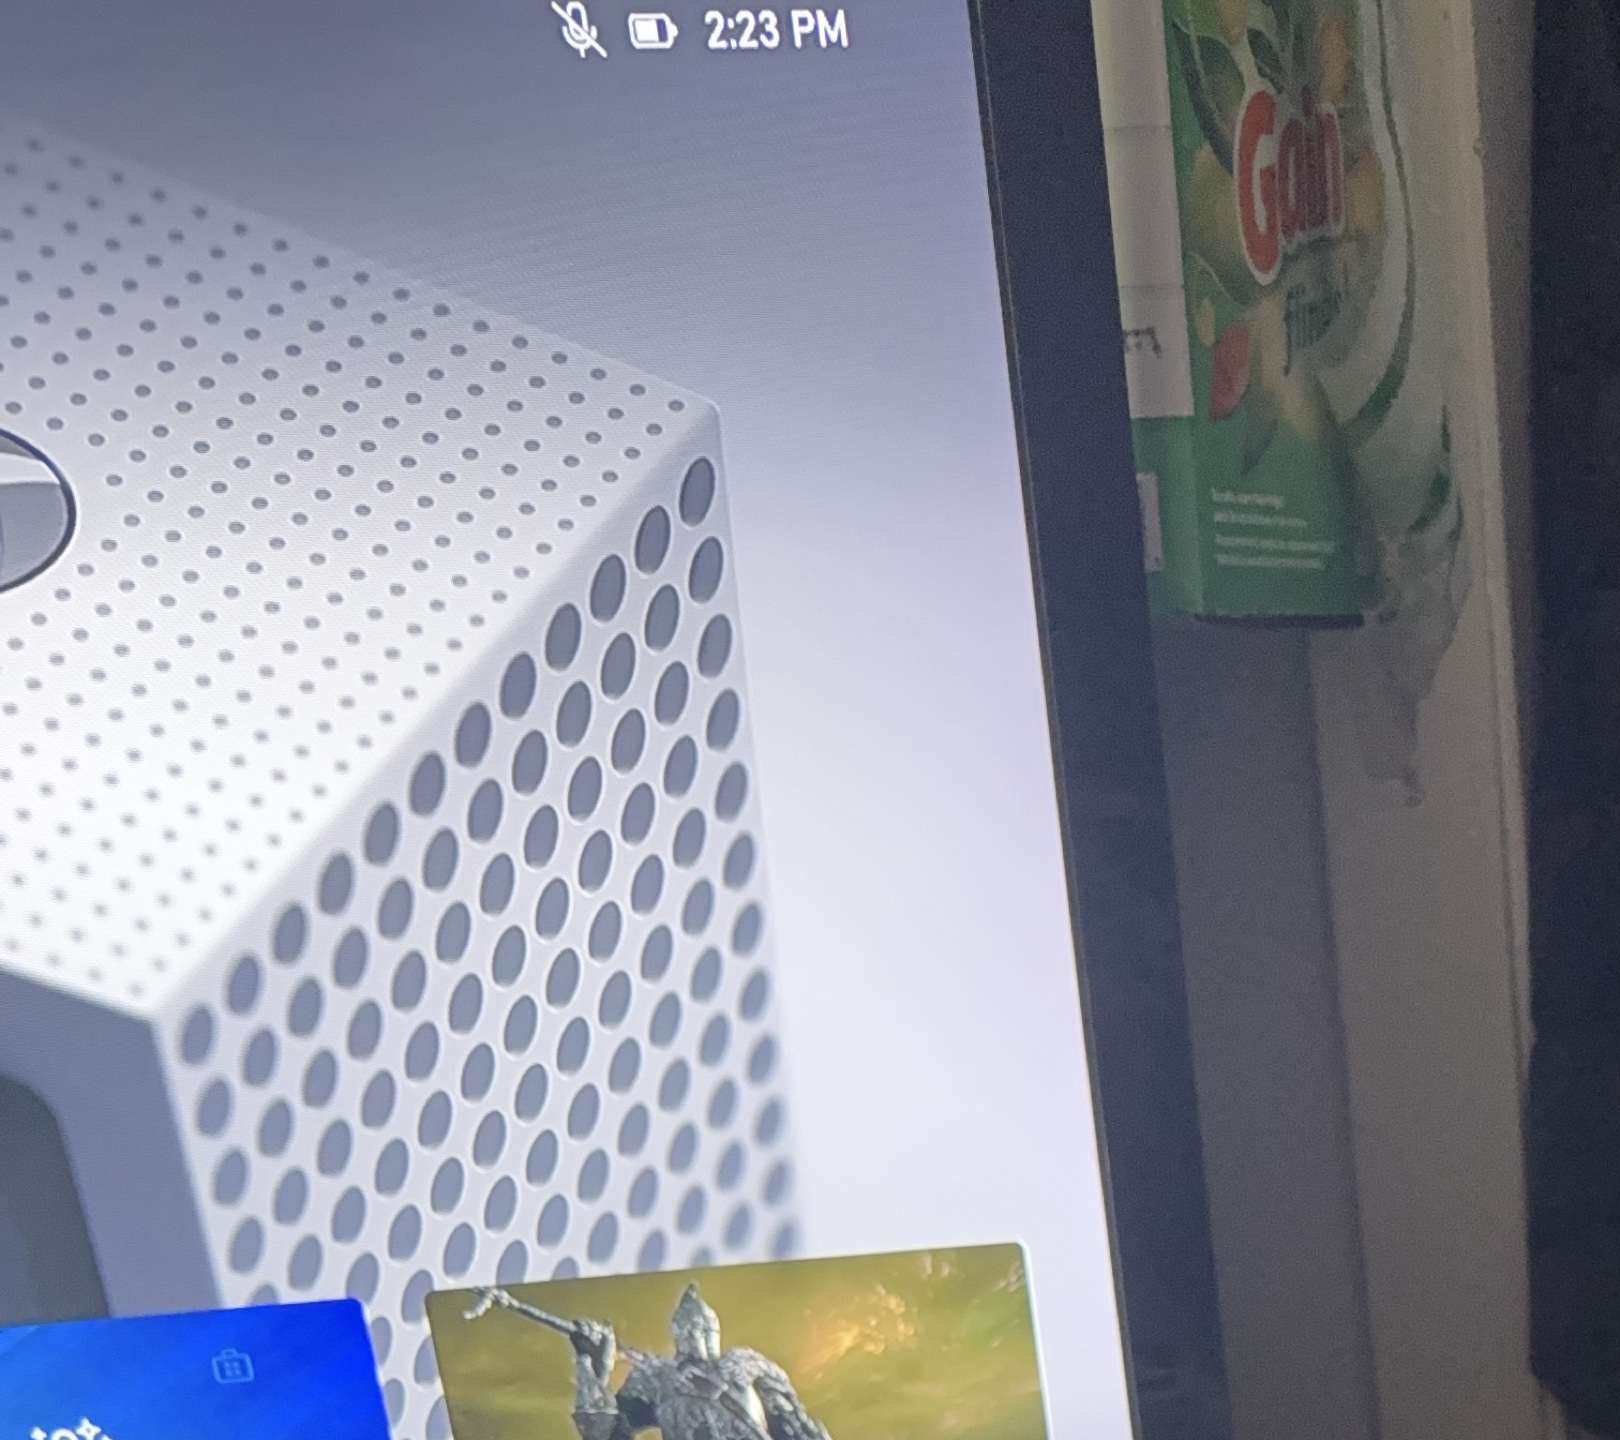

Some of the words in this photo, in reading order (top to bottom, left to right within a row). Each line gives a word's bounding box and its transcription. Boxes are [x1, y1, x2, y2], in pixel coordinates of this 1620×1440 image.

[705, 10, 780, 49] 2:23
[791, 10, 848, 48] PM
[1236, 85, 1344, 280] Gain
